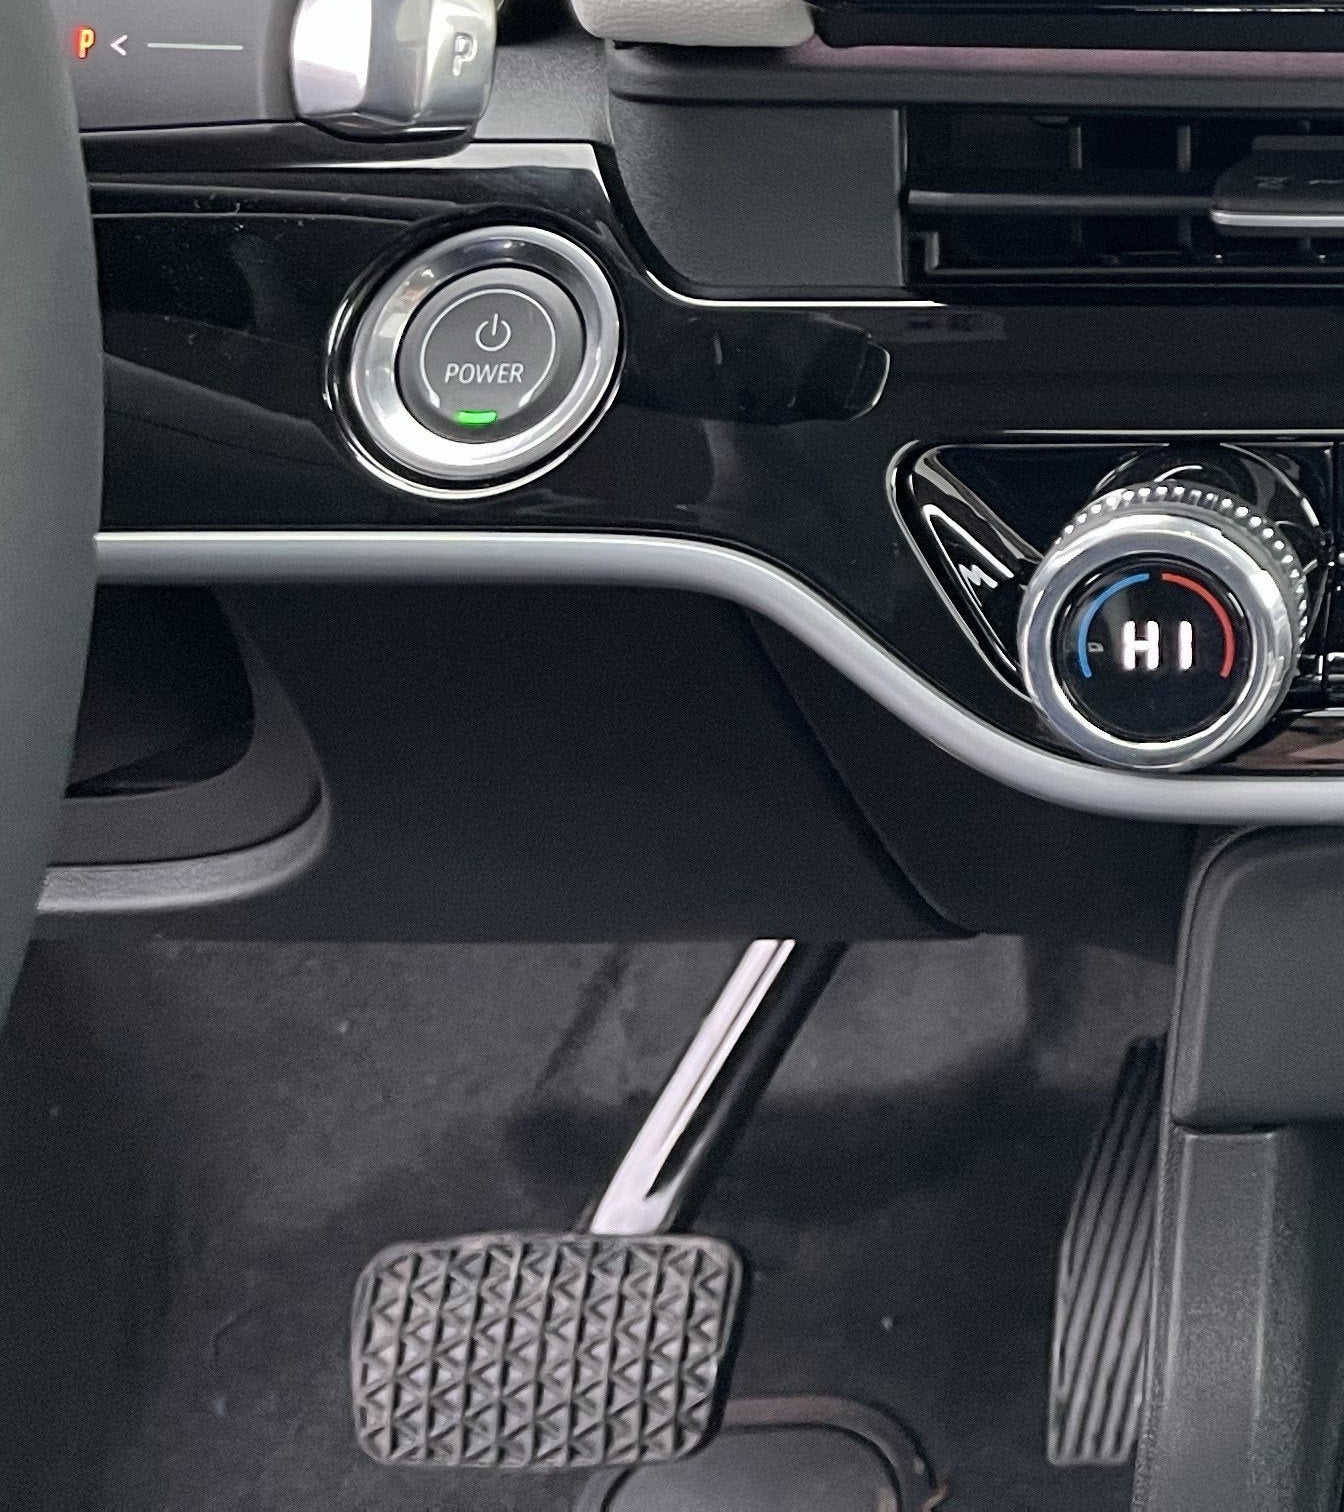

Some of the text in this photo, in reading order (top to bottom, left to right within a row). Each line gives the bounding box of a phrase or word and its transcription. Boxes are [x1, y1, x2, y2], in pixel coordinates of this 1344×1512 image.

[76, 25, 97, 60] P
[451, 30, 479, 78] P
[444, 362, 524, 384] POWER
[1121, 620, 1193, 671] HI
